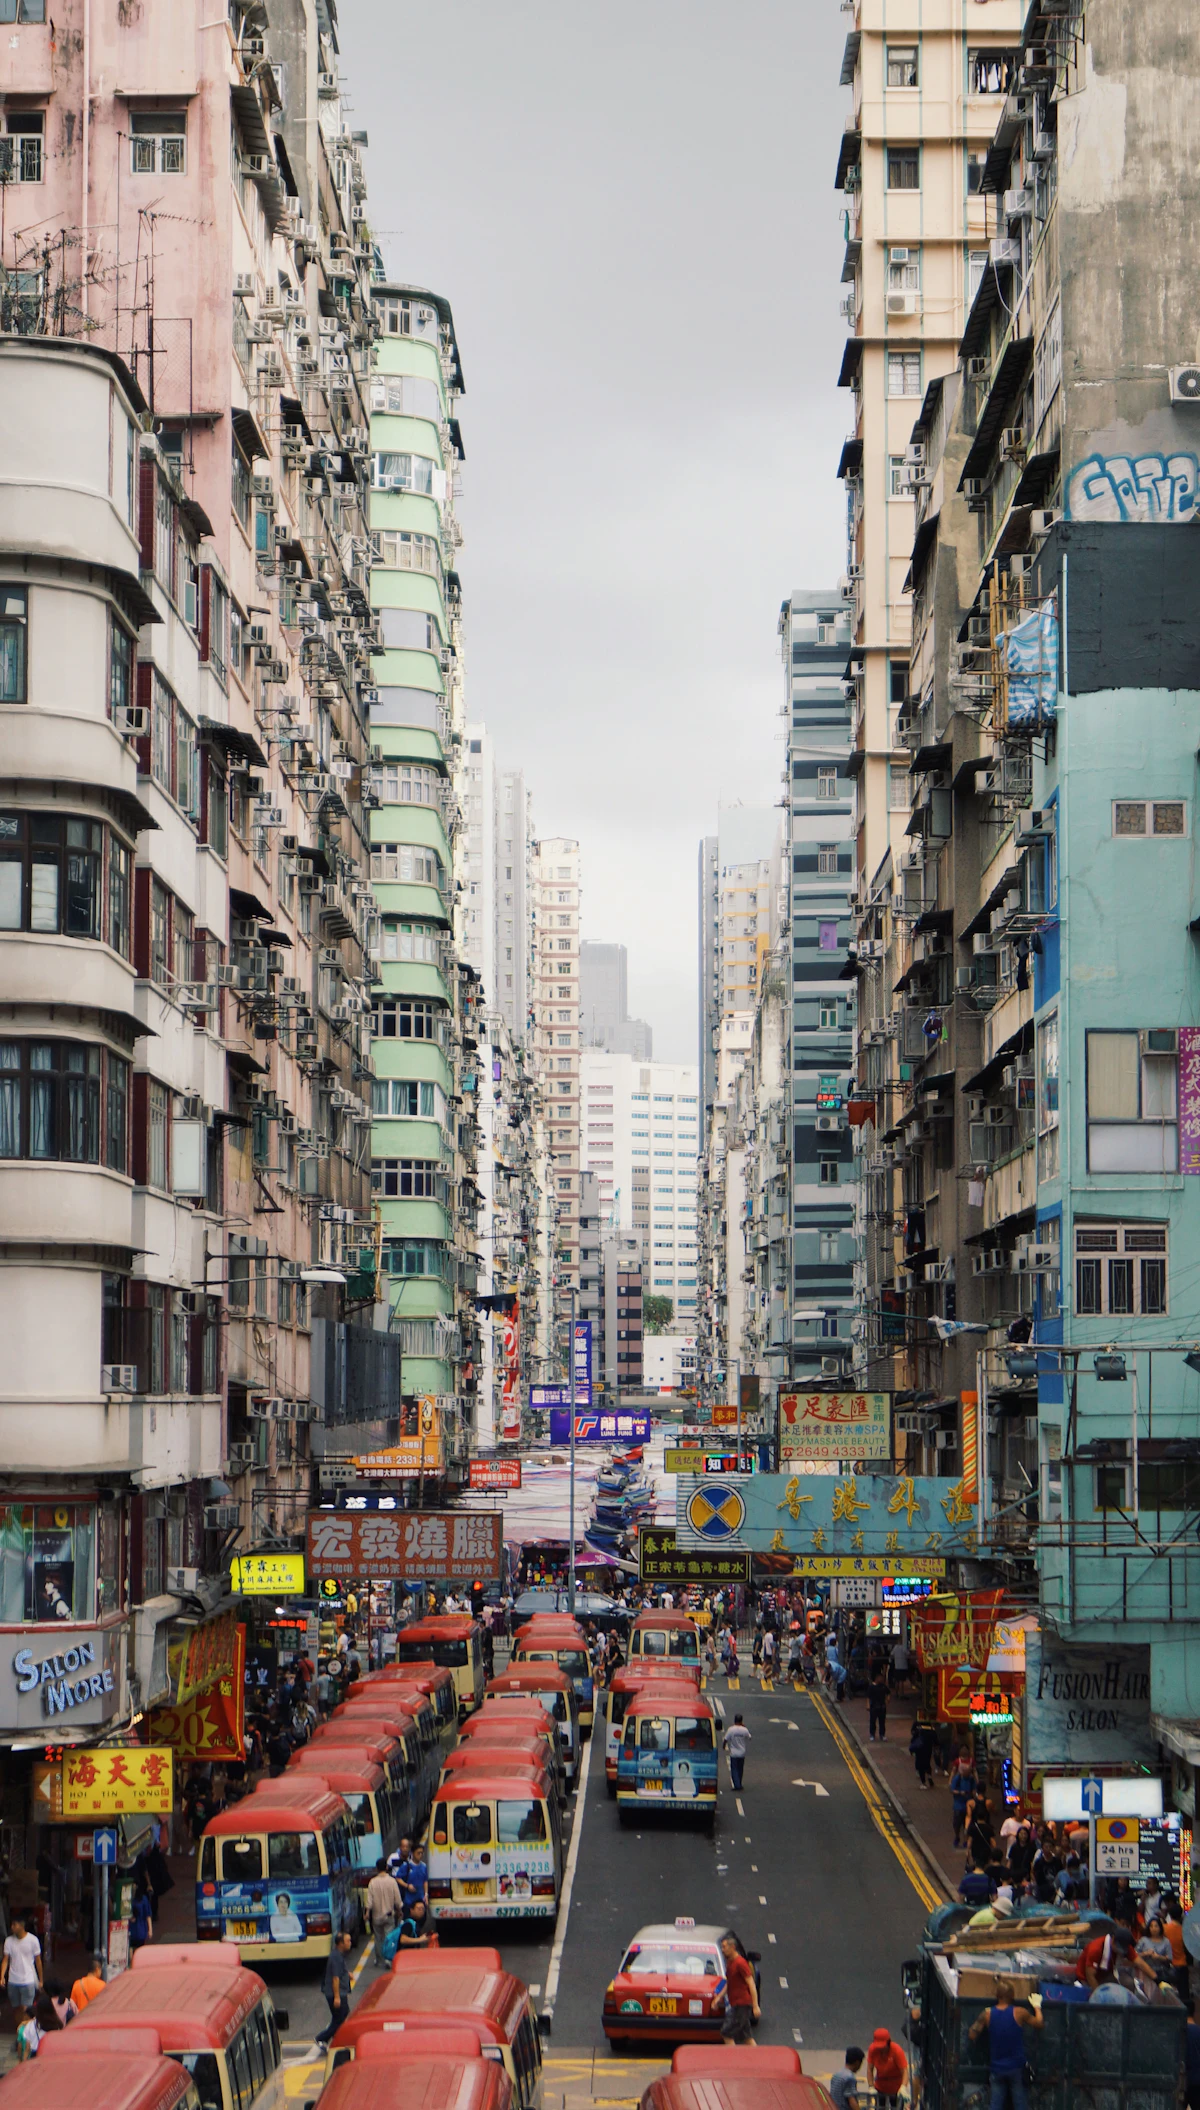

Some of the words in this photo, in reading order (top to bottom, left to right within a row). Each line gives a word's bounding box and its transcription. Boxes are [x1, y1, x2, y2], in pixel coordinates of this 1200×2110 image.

[801, 1395, 869, 1422] 足豪匯
[781, 1437, 804, 1445] FOOT
[806, 1437, 848, 1445] MASSAGE
[851, 1437, 885, 1445] BEAUTY
[796, 1447, 829, 1456] 2649
[832, 1447, 865, 1456] 4333
[868, 1447, 886, 1456] 1/F
[311, 1517, 496, 1560] 宏發燒臘
[14, 1641, 96, 1692] SALON
[925, 1651, 984, 1665] SALON
[47, 1668, 114, 1716] MORE
[160, 1712, 205, 1746] 20
[1066, 1709, 1119, 1730] SALON
[68, 1754, 169, 1787] 海天堂
[133, 1789, 160, 1797] TONG
[1101, 1845, 1115, 1854] 24
[1118, 1845, 1134, 1854] hrs
[1105, 1857, 1130, 1868] 全日
